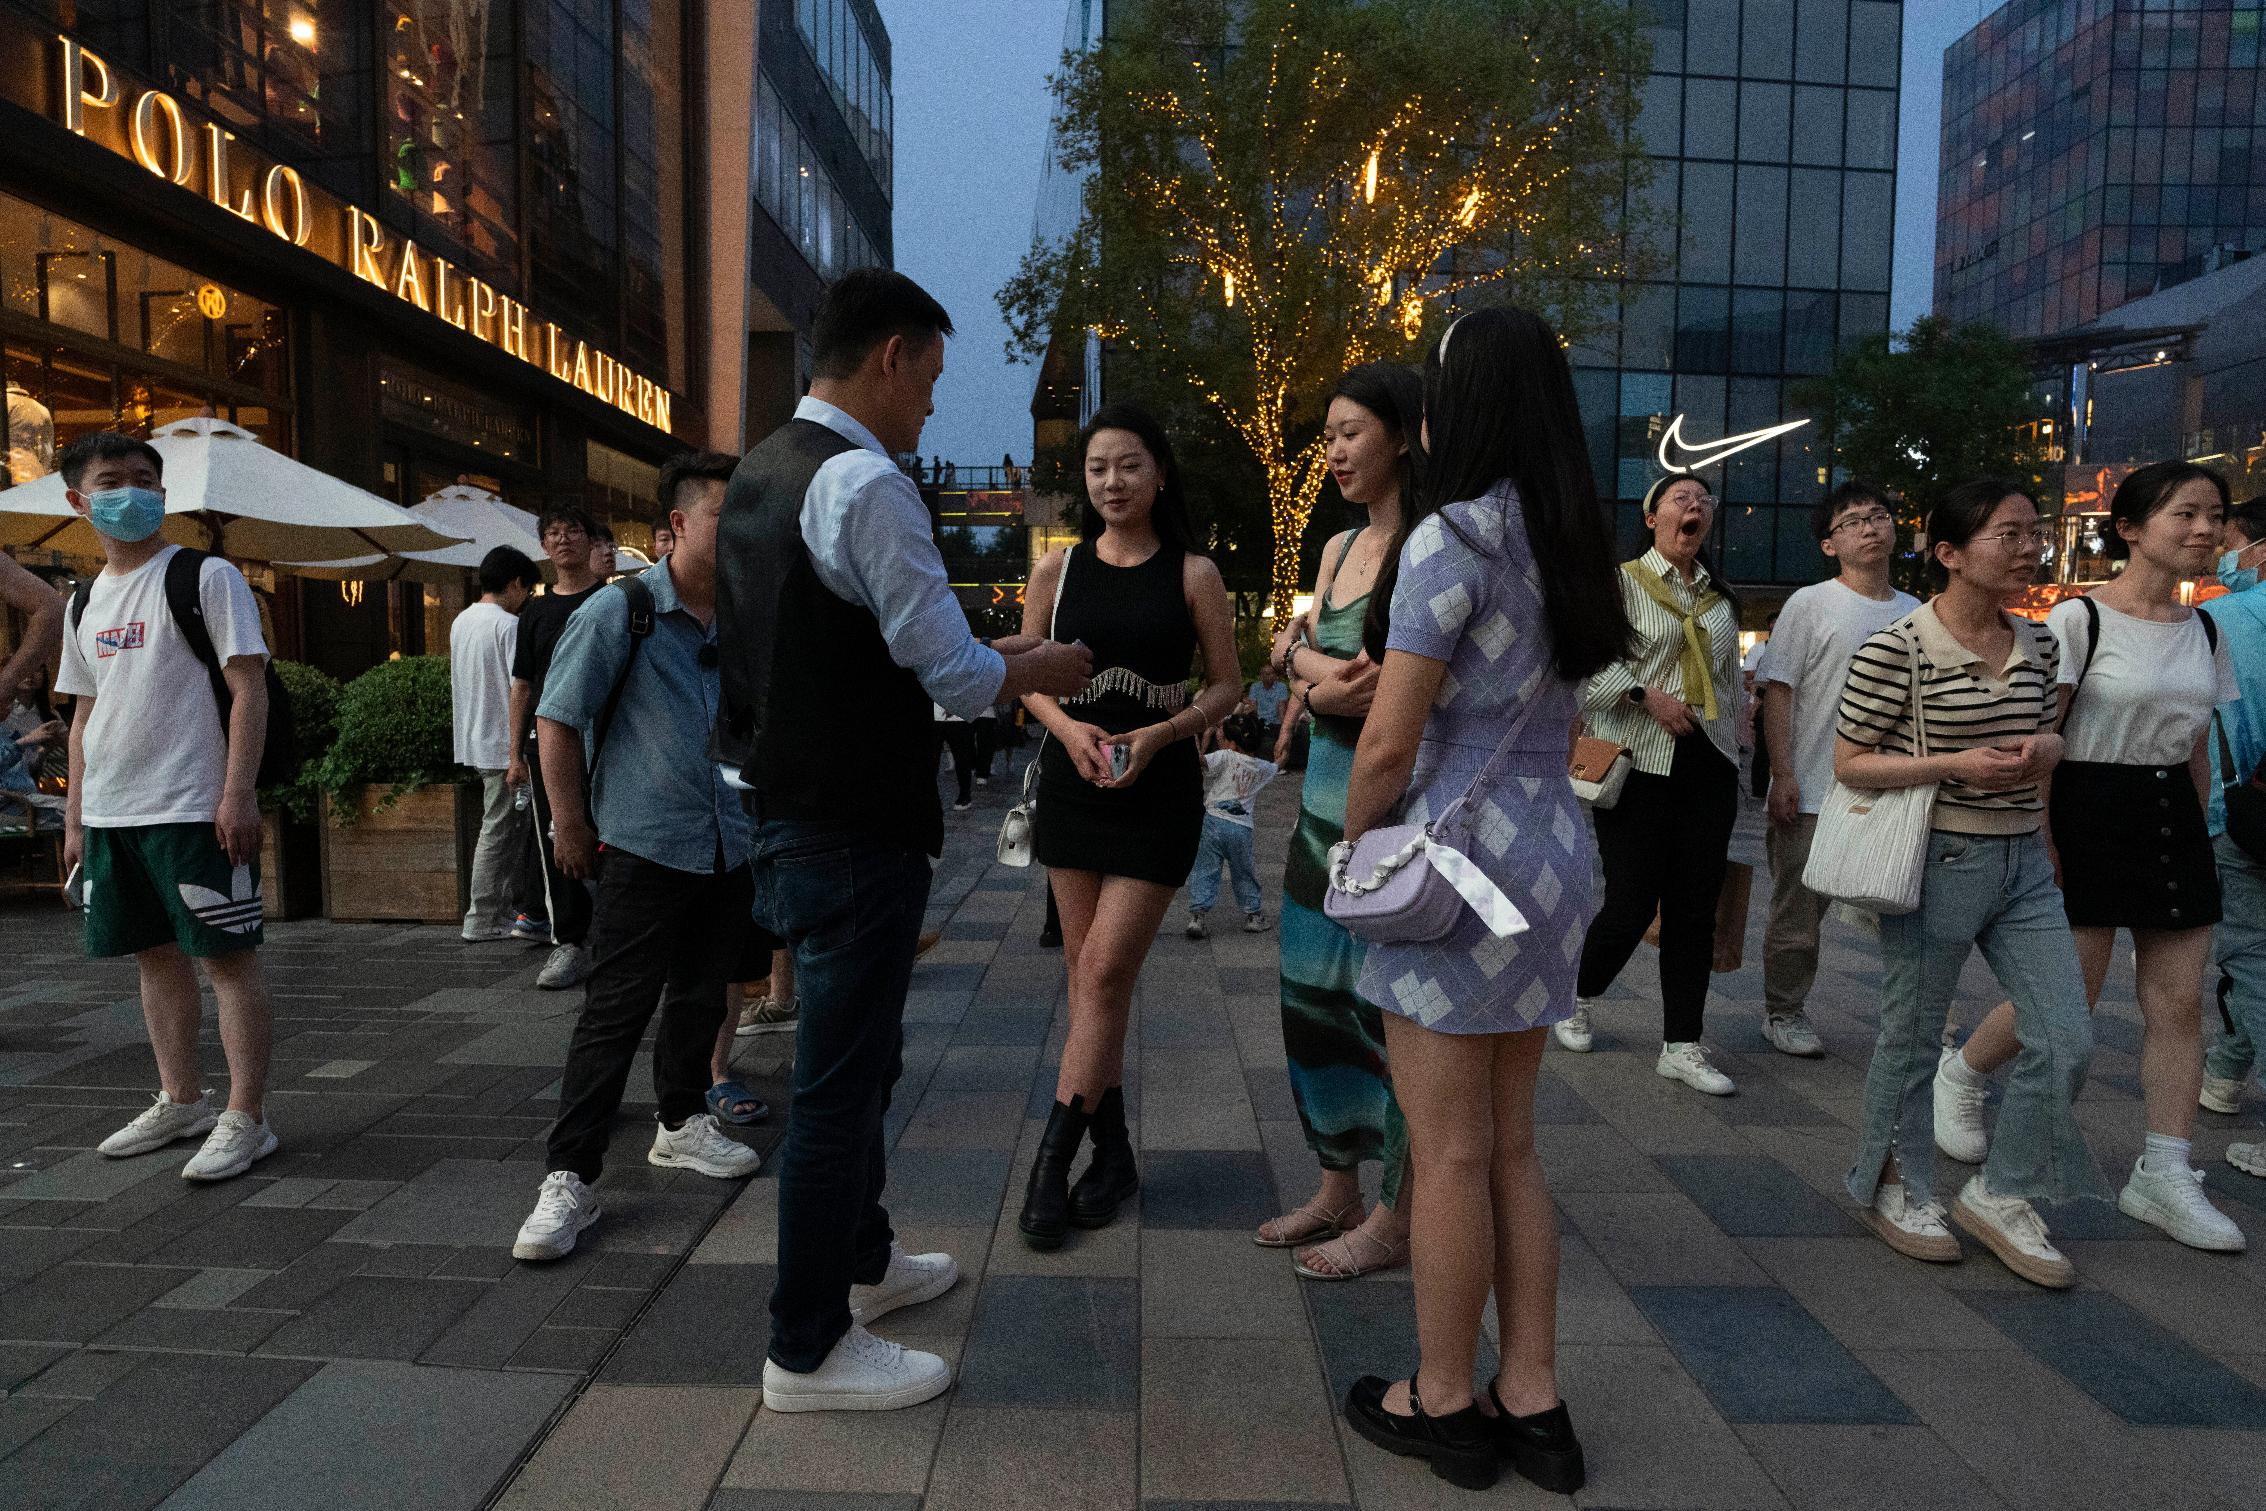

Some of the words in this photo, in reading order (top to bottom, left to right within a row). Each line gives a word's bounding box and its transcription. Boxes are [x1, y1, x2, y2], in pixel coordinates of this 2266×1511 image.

[58, 34, 312, 246] POLO
[350, 205, 530, 363] RALPH
[548, 322, 672, 435] LAUREN
